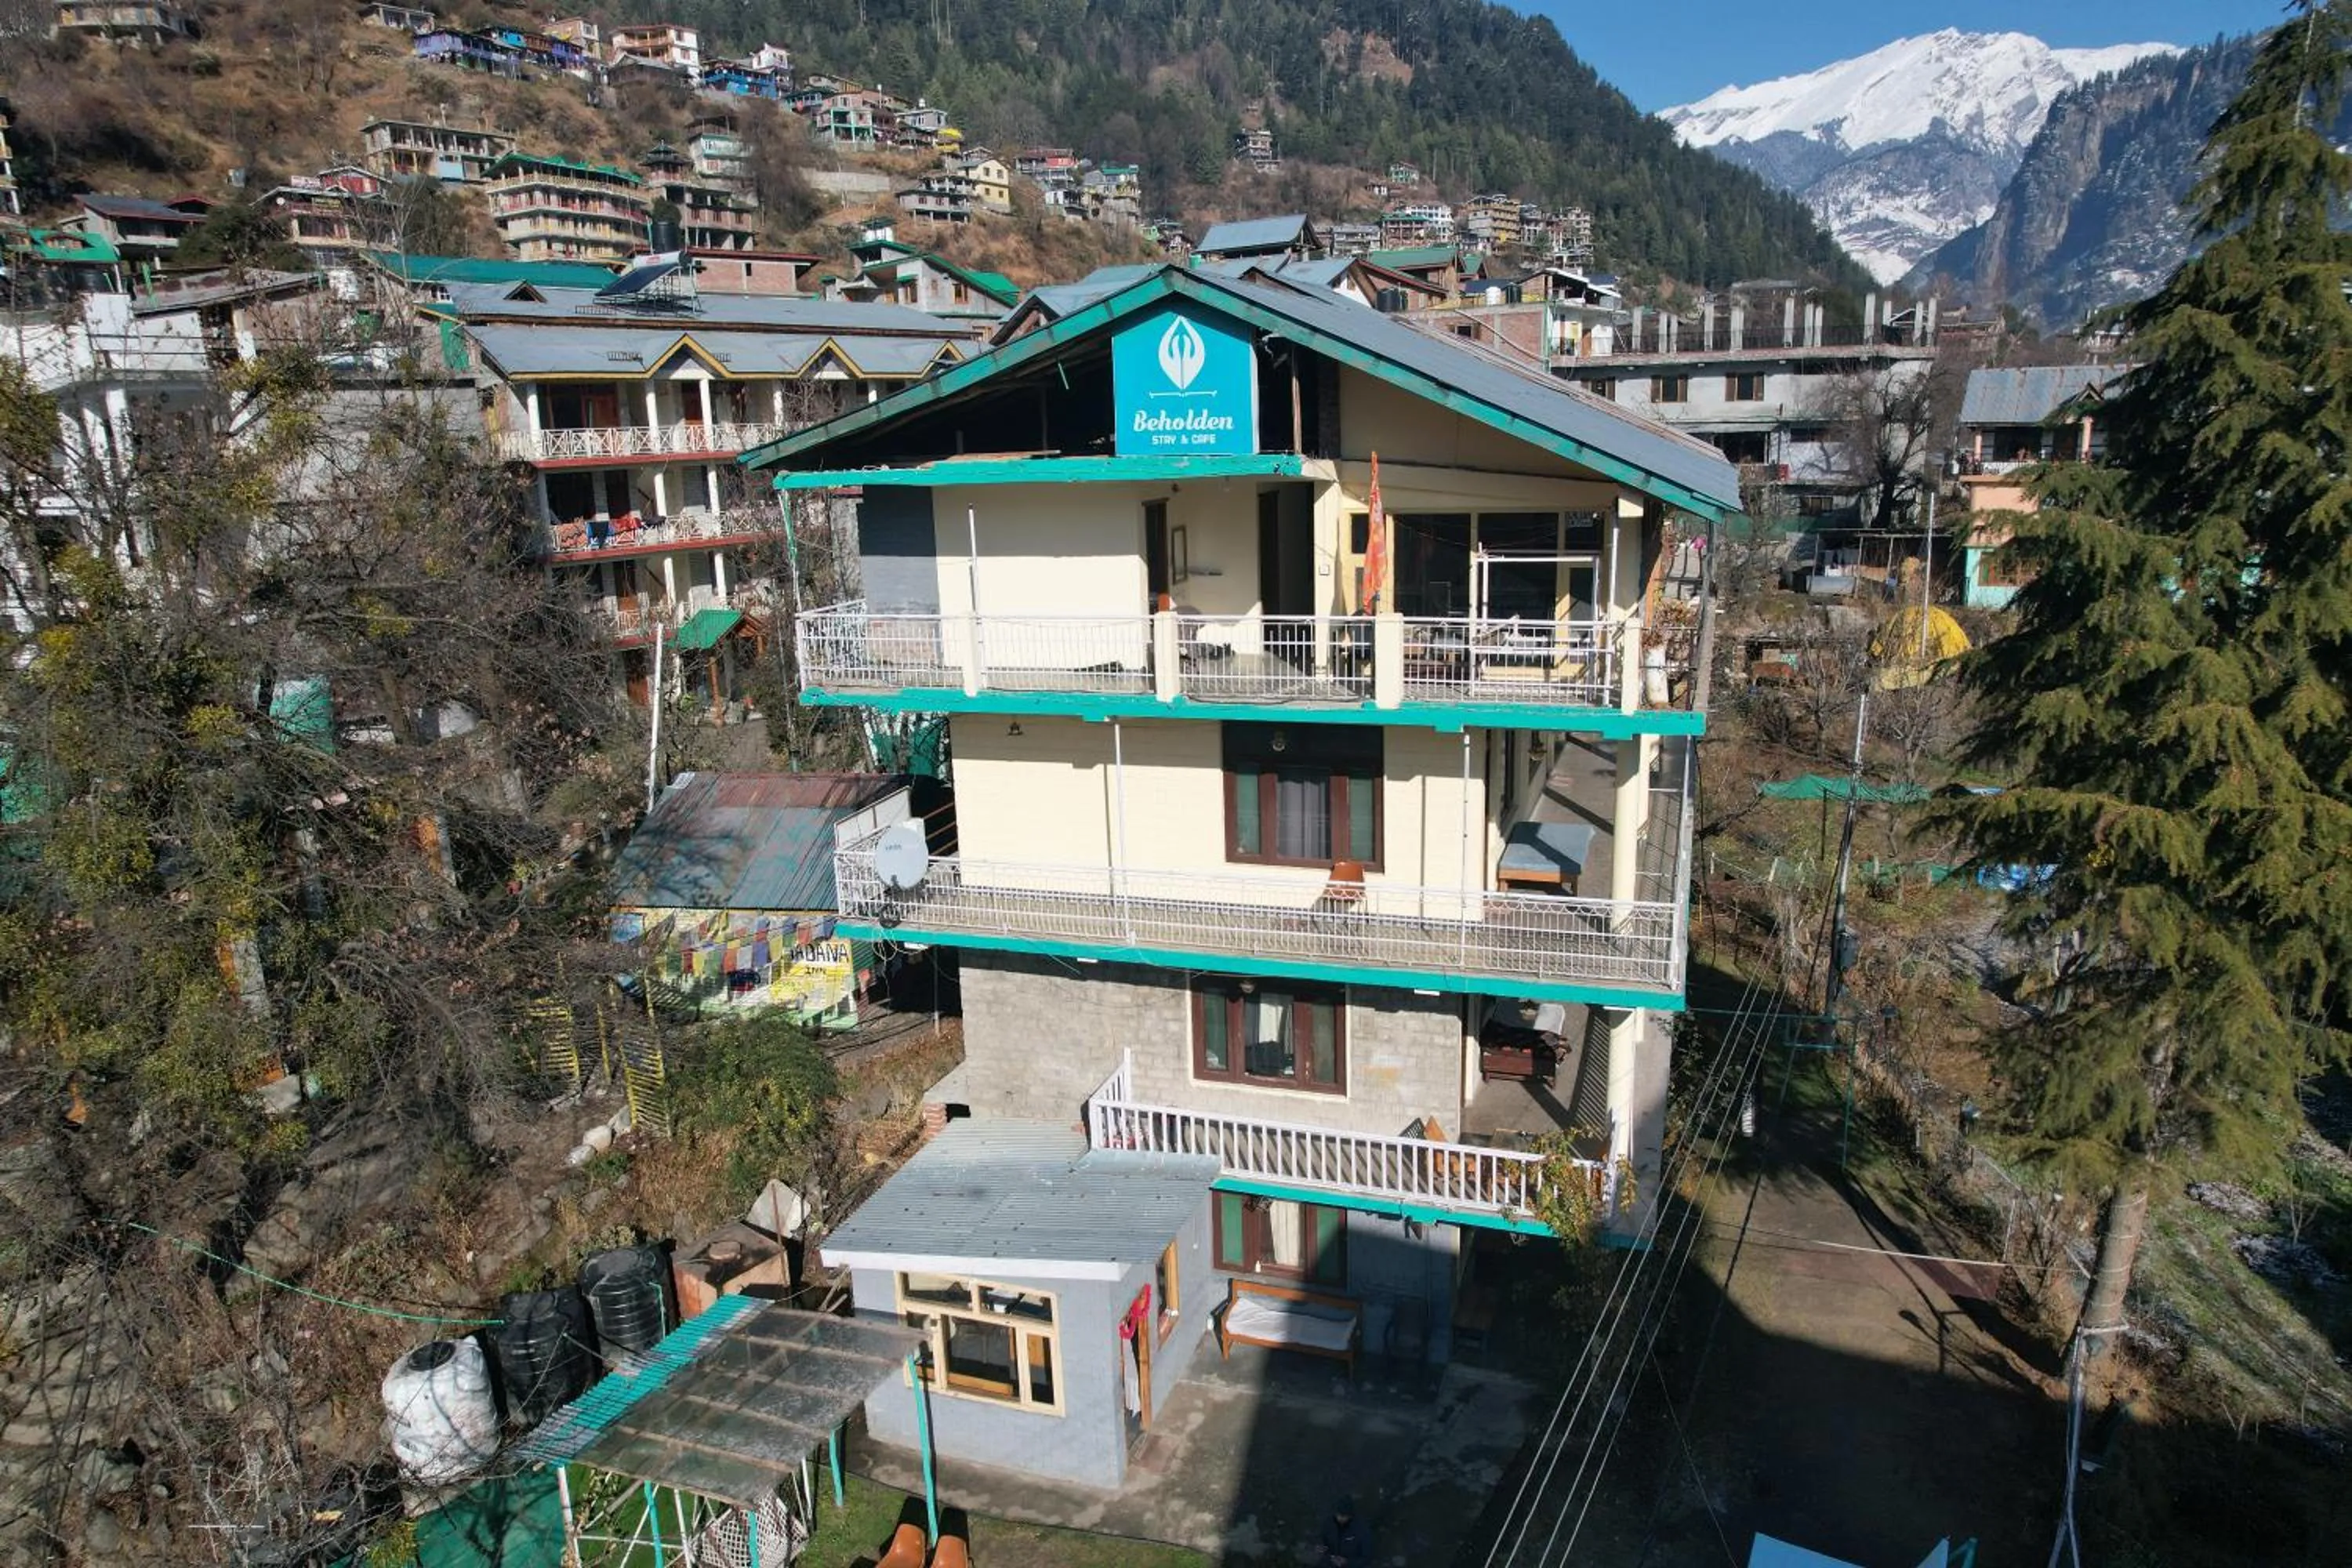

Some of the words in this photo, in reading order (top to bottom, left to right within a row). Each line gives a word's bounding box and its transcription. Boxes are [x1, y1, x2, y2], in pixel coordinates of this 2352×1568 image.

[1133, 408, 1234, 432] Beholden
[1152, 434, 1176, 445] STAY
[1181, 434, 1189, 445] &
[1192, 434, 1217, 445] CAFE
